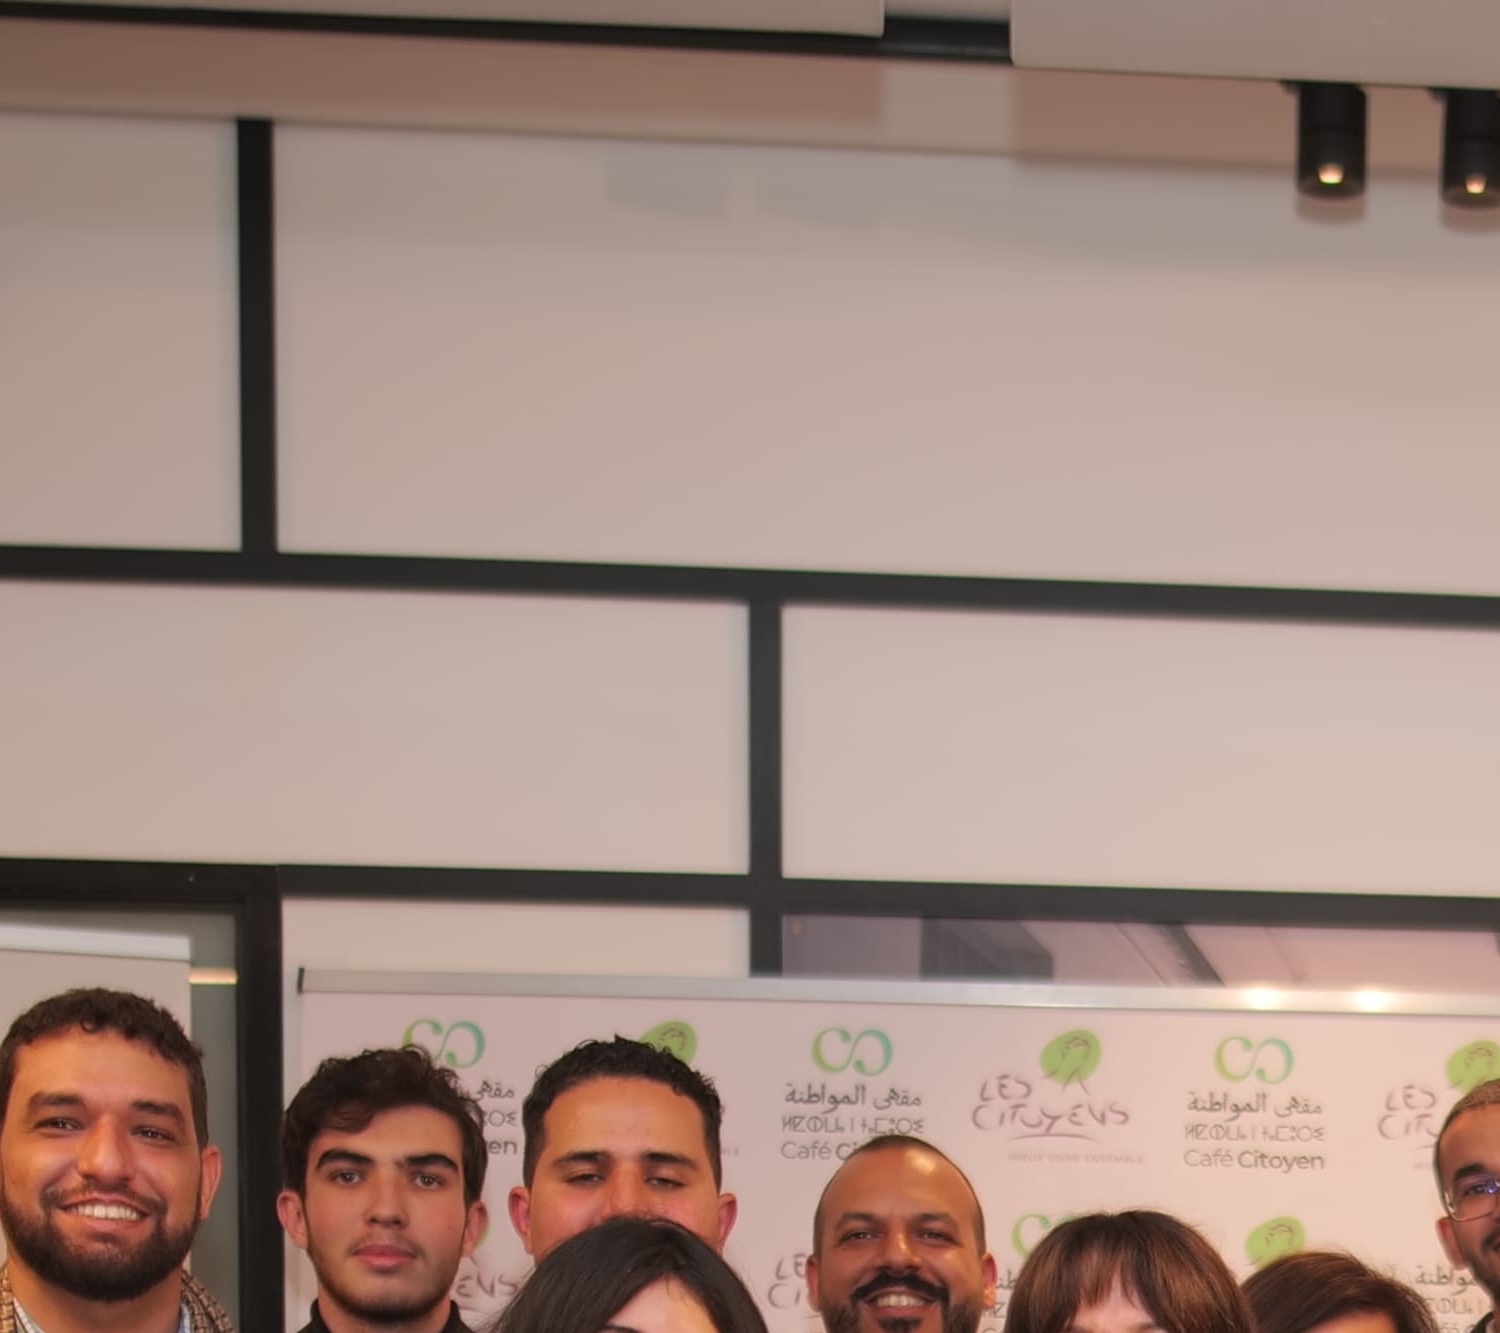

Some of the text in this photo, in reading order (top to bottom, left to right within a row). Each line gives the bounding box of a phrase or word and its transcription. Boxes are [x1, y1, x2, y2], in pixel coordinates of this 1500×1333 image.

[784, 1082, 922, 1115] مقهى المواطنة
[979, 1073, 1033, 1101] LES
[1385, 1084, 1438, 1111] LES
[1186, 1090, 1323, 1123] مقهى المواطنة
[780, 1139, 832, 1160] Café
[1183, 1147, 1325, 1174] Café Citoyen
